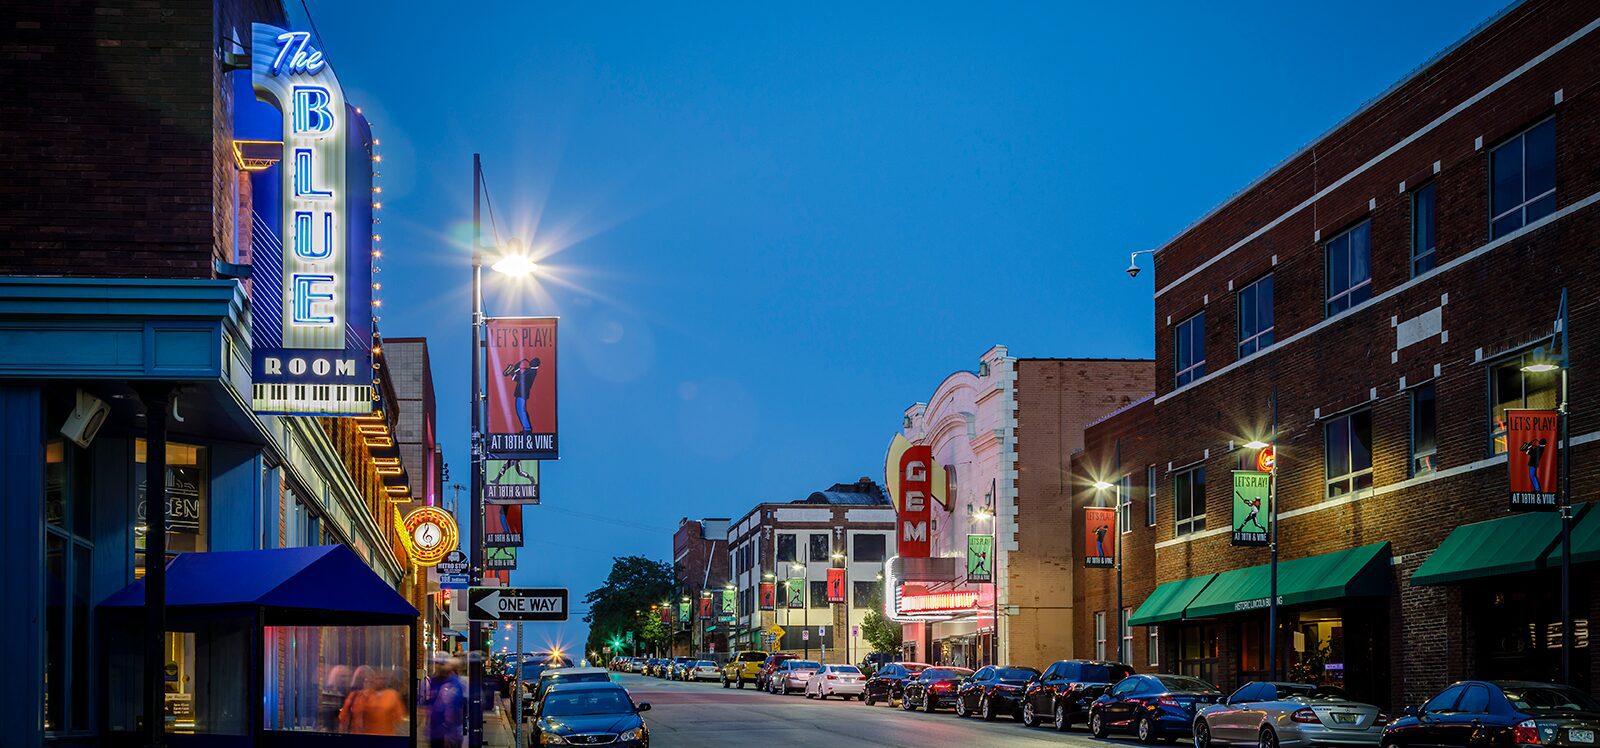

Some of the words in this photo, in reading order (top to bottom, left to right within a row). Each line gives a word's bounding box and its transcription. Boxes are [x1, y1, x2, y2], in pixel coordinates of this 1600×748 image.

[271, 31, 324, 76] The
[292, 84, 335, 325] BLUE
[490, 328, 519, 348] LET'S
[522, 328, 553, 348] PLAY!
[265, 358, 355, 376] ROOM
[1510, 416, 1531, 431] LET'S
[1533, 416, 1556, 431] PLAY!
[491, 435, 502, 449] AT
[505, 435, 524, 449] 18TH
[526, 435, 533, 449] &
[535, 435, 554, 449] VINE
[1234, 476, 1250, 487] LET'S
[1251, 476, 1268, 488] PLAY!
[488, 486, 497, 497] AT
[498, 486, 514, 497] 18TH
[515, 486, 521, 497] &
[522, 486, 536, 497] VINE
[1512, 493, 1520, 504] AT
[1521, 493, 1535, 504] 18TH
[1536, 493, 1541, 504] &
[1542, 493, 1556, 504] VINE
[903, 460, 927, 542] GEM
[487, 534, 494, 543] AT
[494, 534, 506, 543] 18TH
[506, 534, 511, 542] &
[511, 533, 521, 542] VINE
[1234, 532, 1241, 541] AT
[498, 598, 525, 611] ONE
[529, 598, 558, 611] WAY
